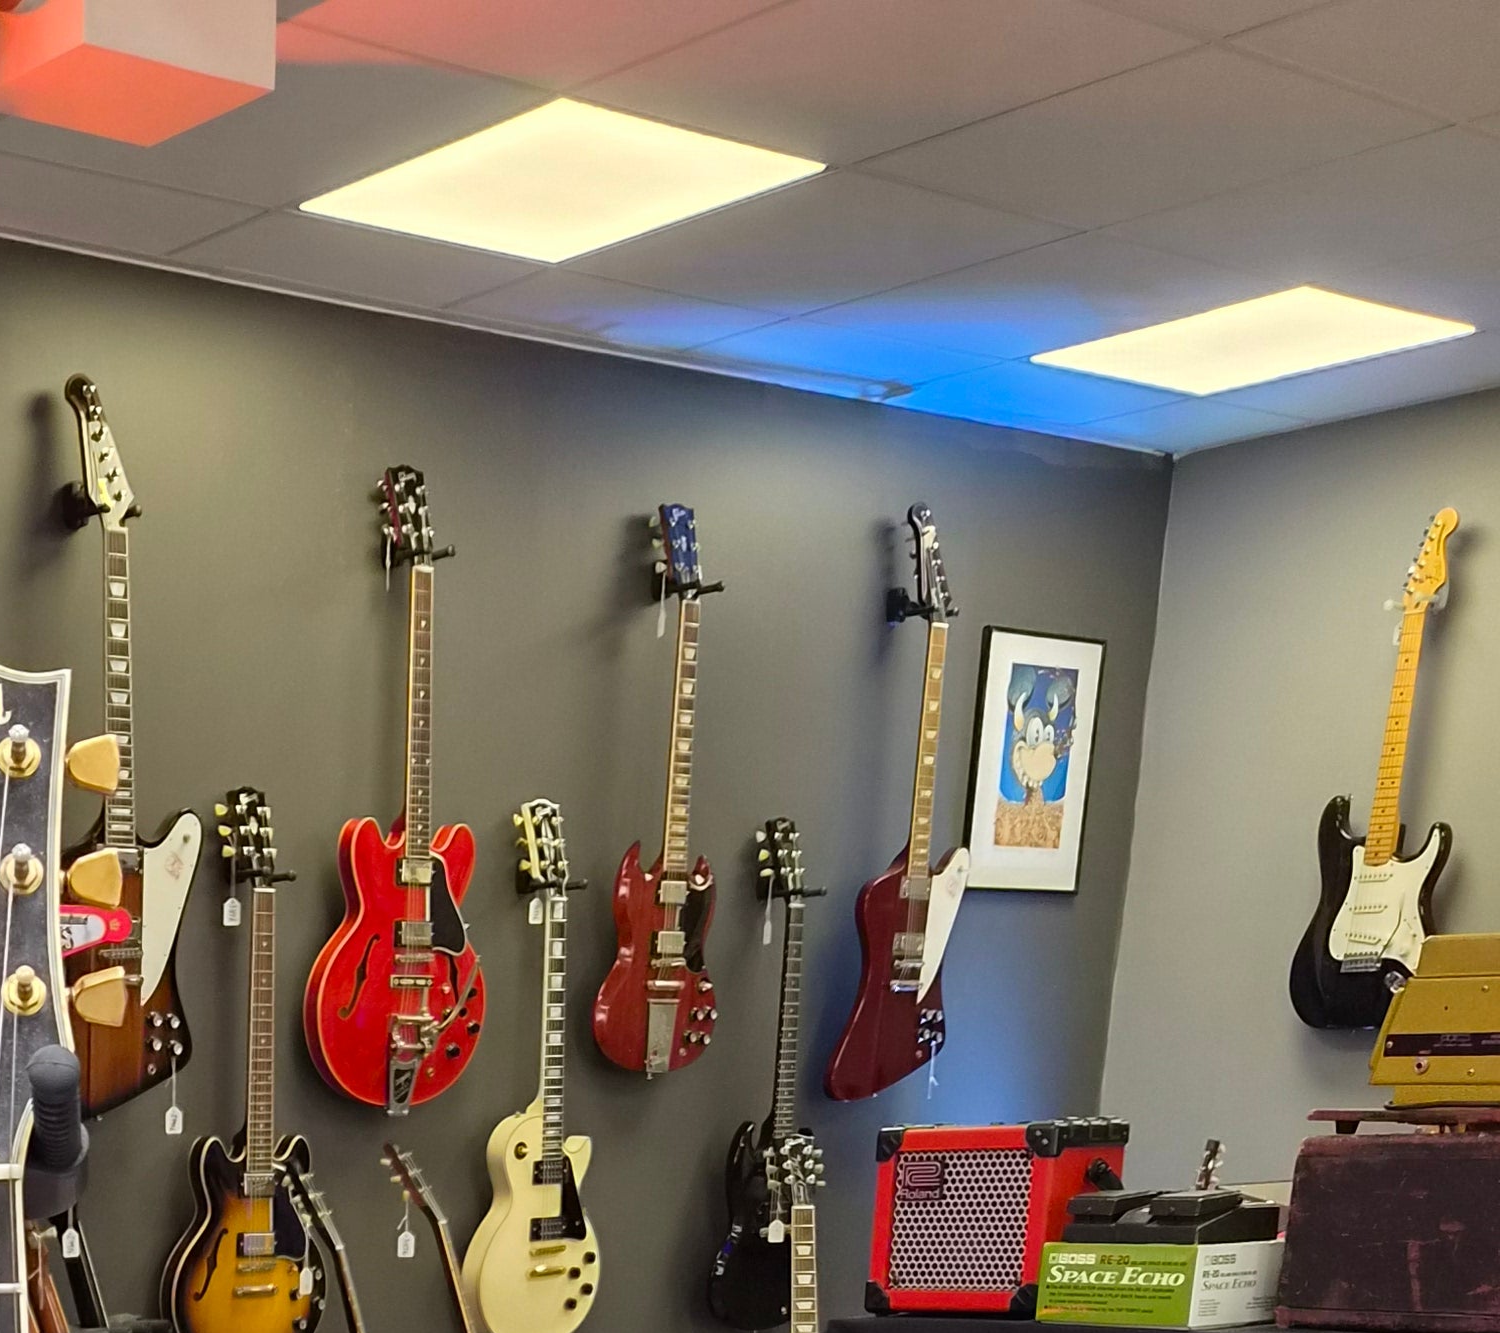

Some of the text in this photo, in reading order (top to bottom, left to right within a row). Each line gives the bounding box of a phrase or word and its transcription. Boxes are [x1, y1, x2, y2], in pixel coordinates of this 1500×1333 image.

[900, 1188, 940, 1200] Roland
[1059, 1253, 1096, 1265] BOSS
[1100, 1255, 1130, 1266] RE-20
[1046, 1265, 1186, 1286] SPACE ECHO
